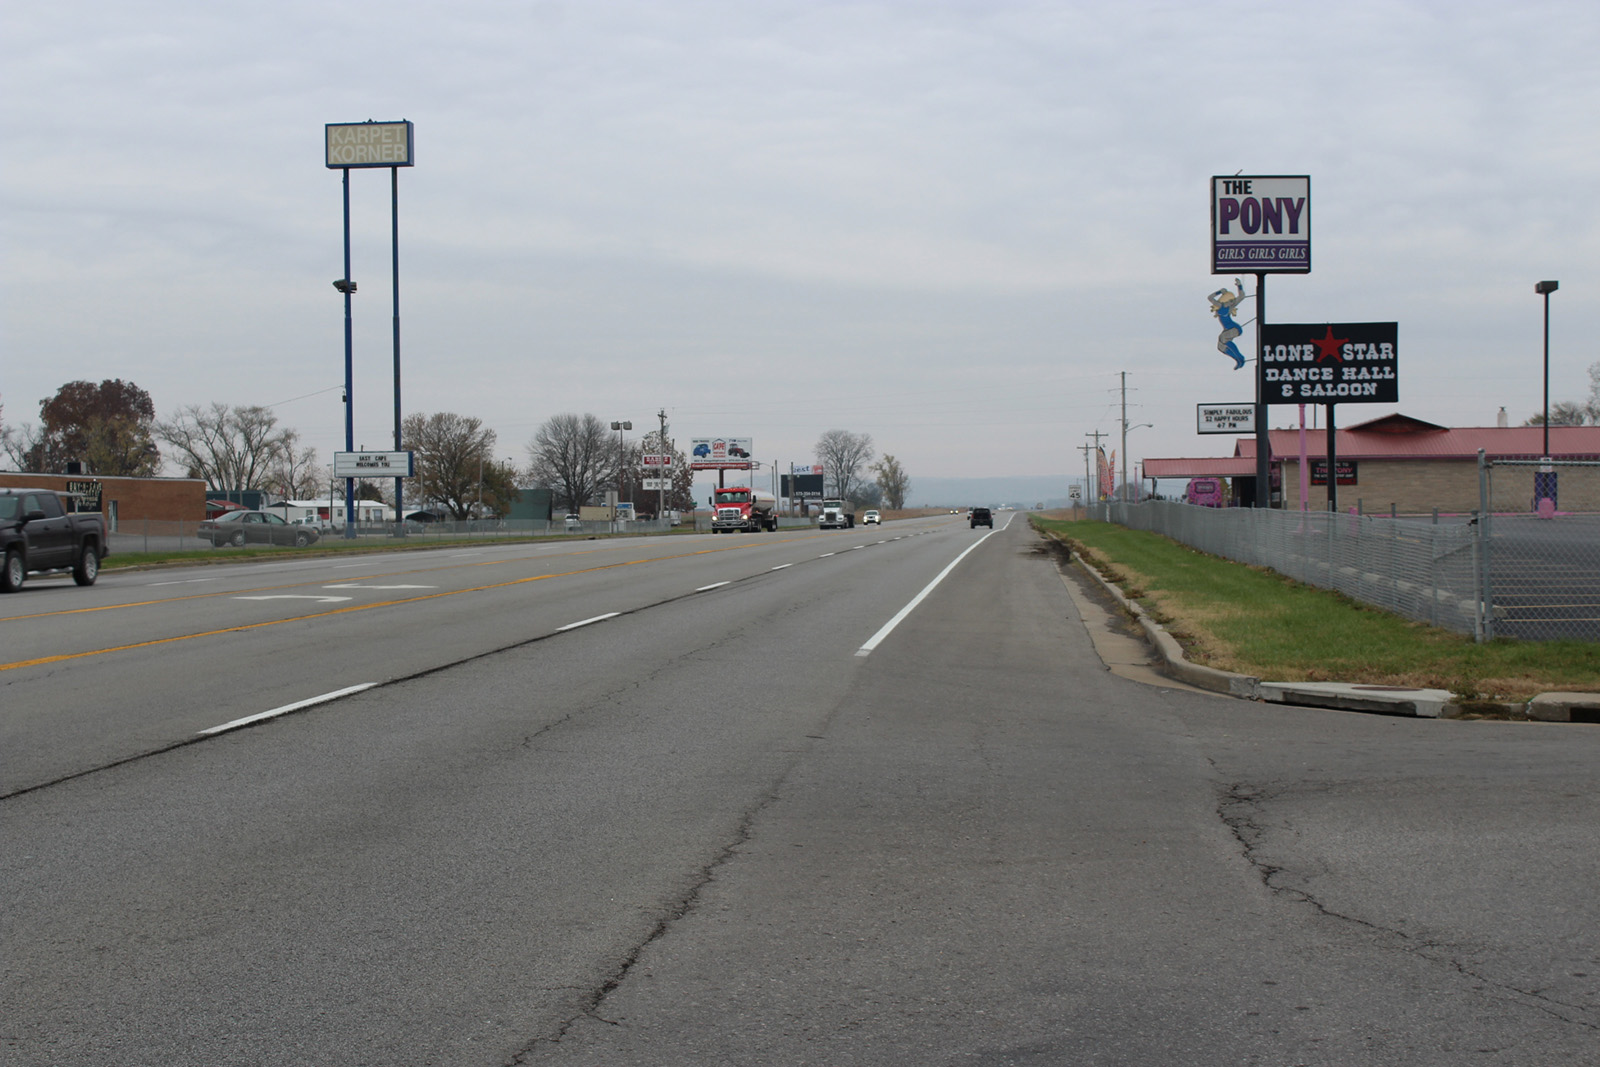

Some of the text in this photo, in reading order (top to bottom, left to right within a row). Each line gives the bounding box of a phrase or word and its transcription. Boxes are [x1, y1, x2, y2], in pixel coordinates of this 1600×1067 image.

[331, 126, 404, 144] KARPET
[330, 144, 406, 162] KORNER
[1223, 180, 1252, 195] THE
[1219, 197, 1306, 235] PONY
[1218, 248, 1306, 259] GIRLS GIRLS GIRLS
[1263, 343, 1394, 362] LONE STAR
[1265, 366, 1395, 381] DANCE HALL
[1281, 382, 1378, 397] & SALOON
